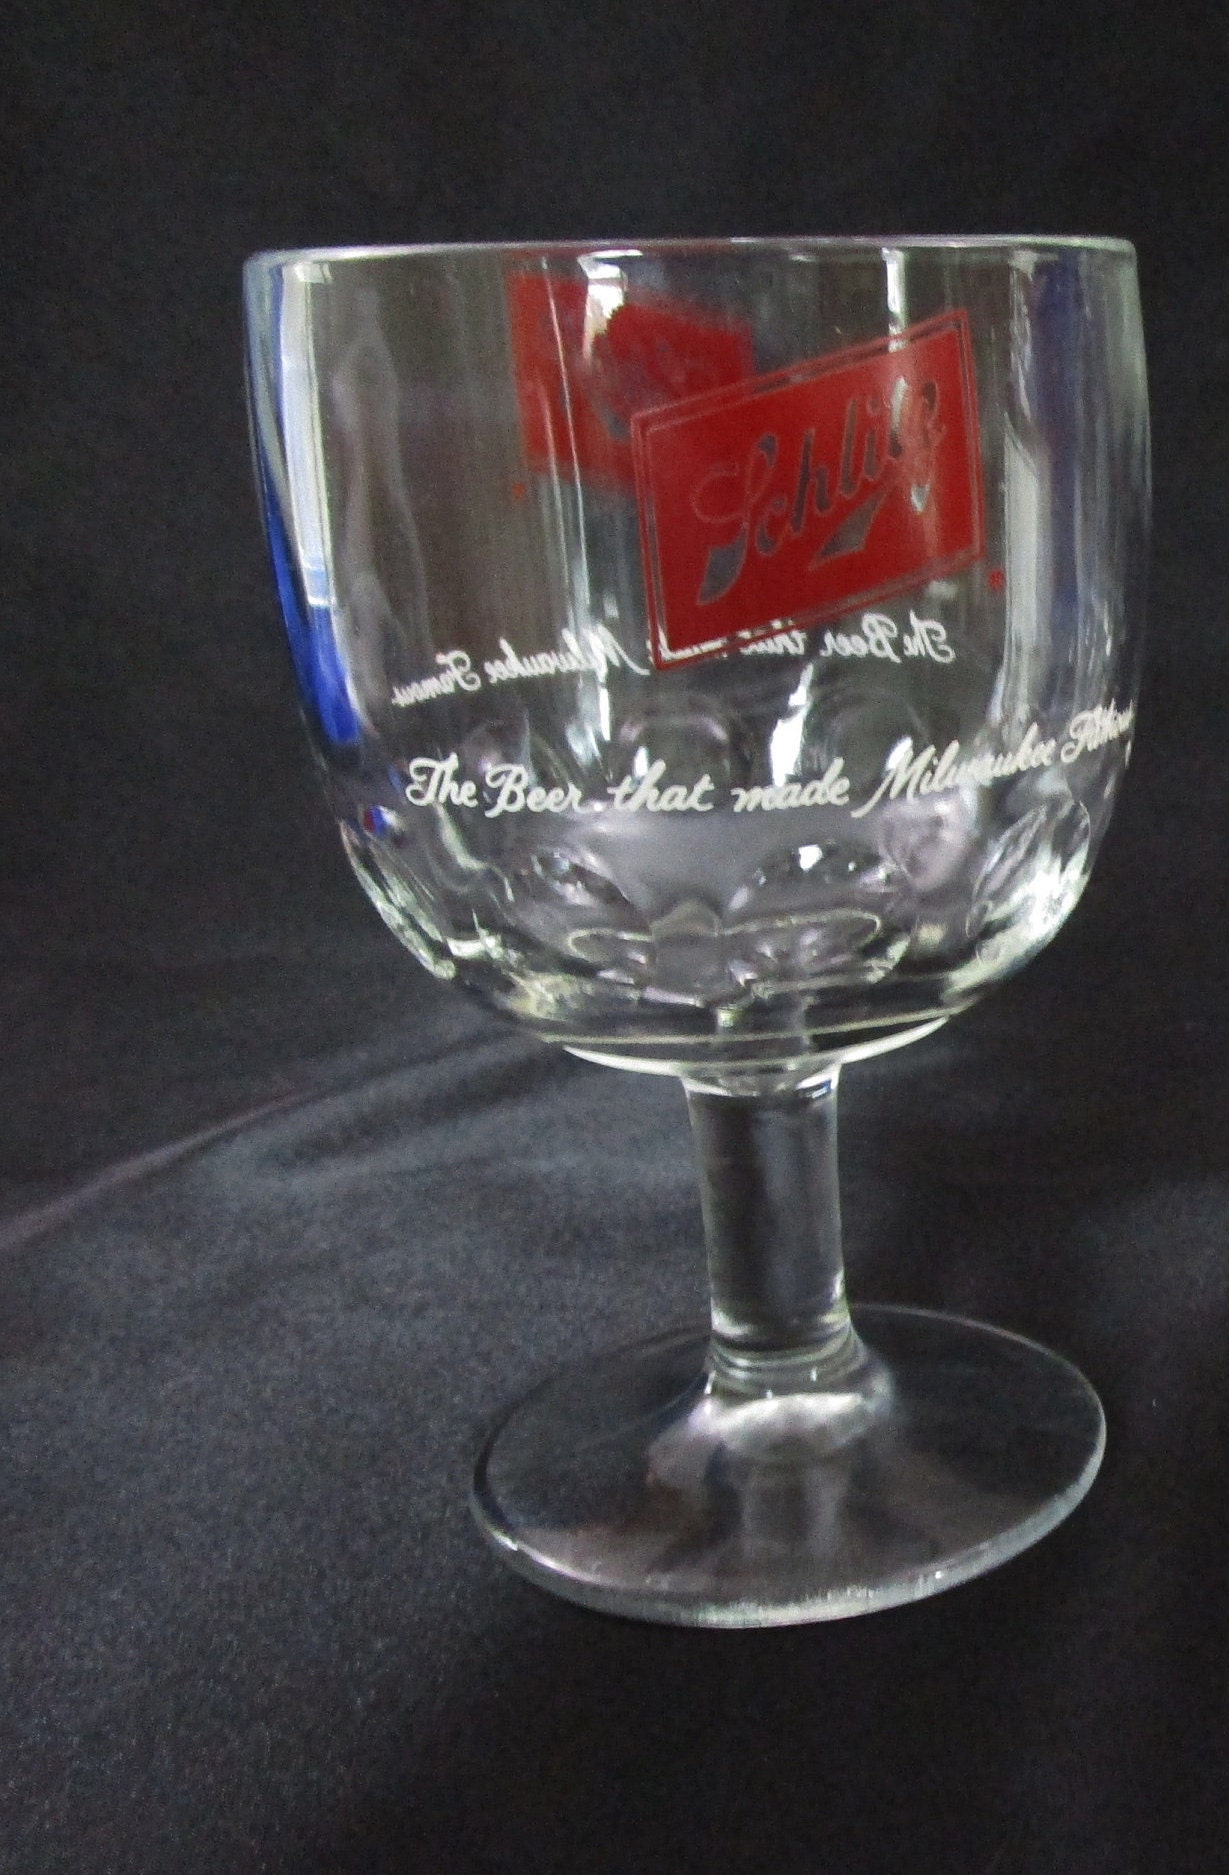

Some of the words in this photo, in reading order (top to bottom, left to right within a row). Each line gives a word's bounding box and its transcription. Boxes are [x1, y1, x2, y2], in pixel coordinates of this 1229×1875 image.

[692, 380, 947, 606] Schlitz
[405, 752, 478, 807] The
[484, 763, 604, 818] Beer
[607, 758, 714, 813] that
[731, 756, 850, 811] made
[850, 736, 1057, 818] Milwaukee
